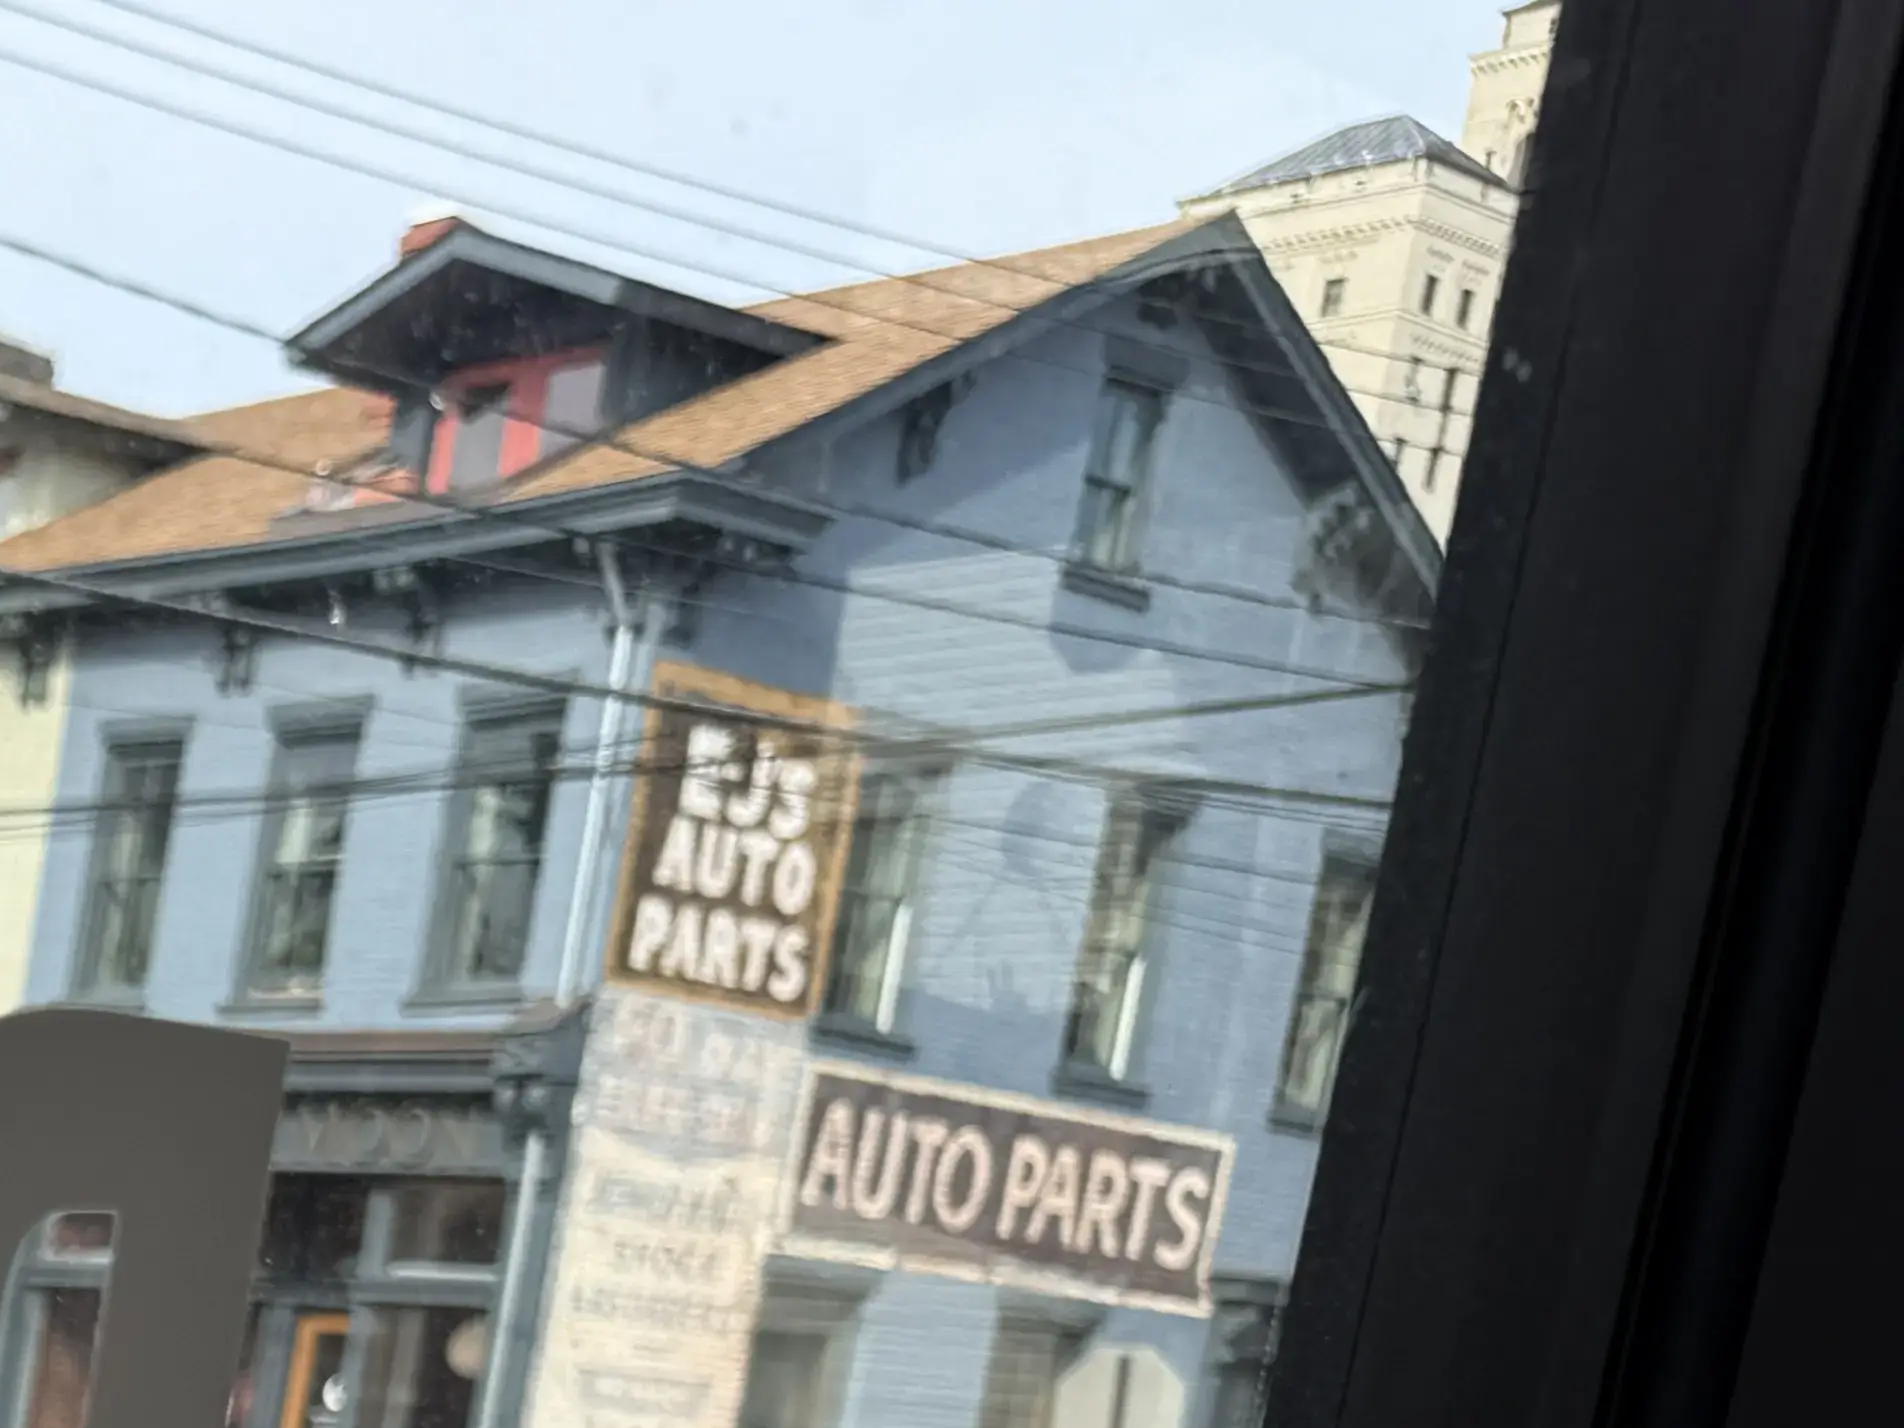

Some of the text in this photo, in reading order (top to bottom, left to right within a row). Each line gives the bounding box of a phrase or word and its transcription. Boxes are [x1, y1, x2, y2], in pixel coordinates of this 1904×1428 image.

[652, 813, 818, 916] AUTO
[628, 895, 809, 1002] PARTS
[800, 1097, 991, 1233] AUTO
[995, 1135, 1209, 1271] PARTS
